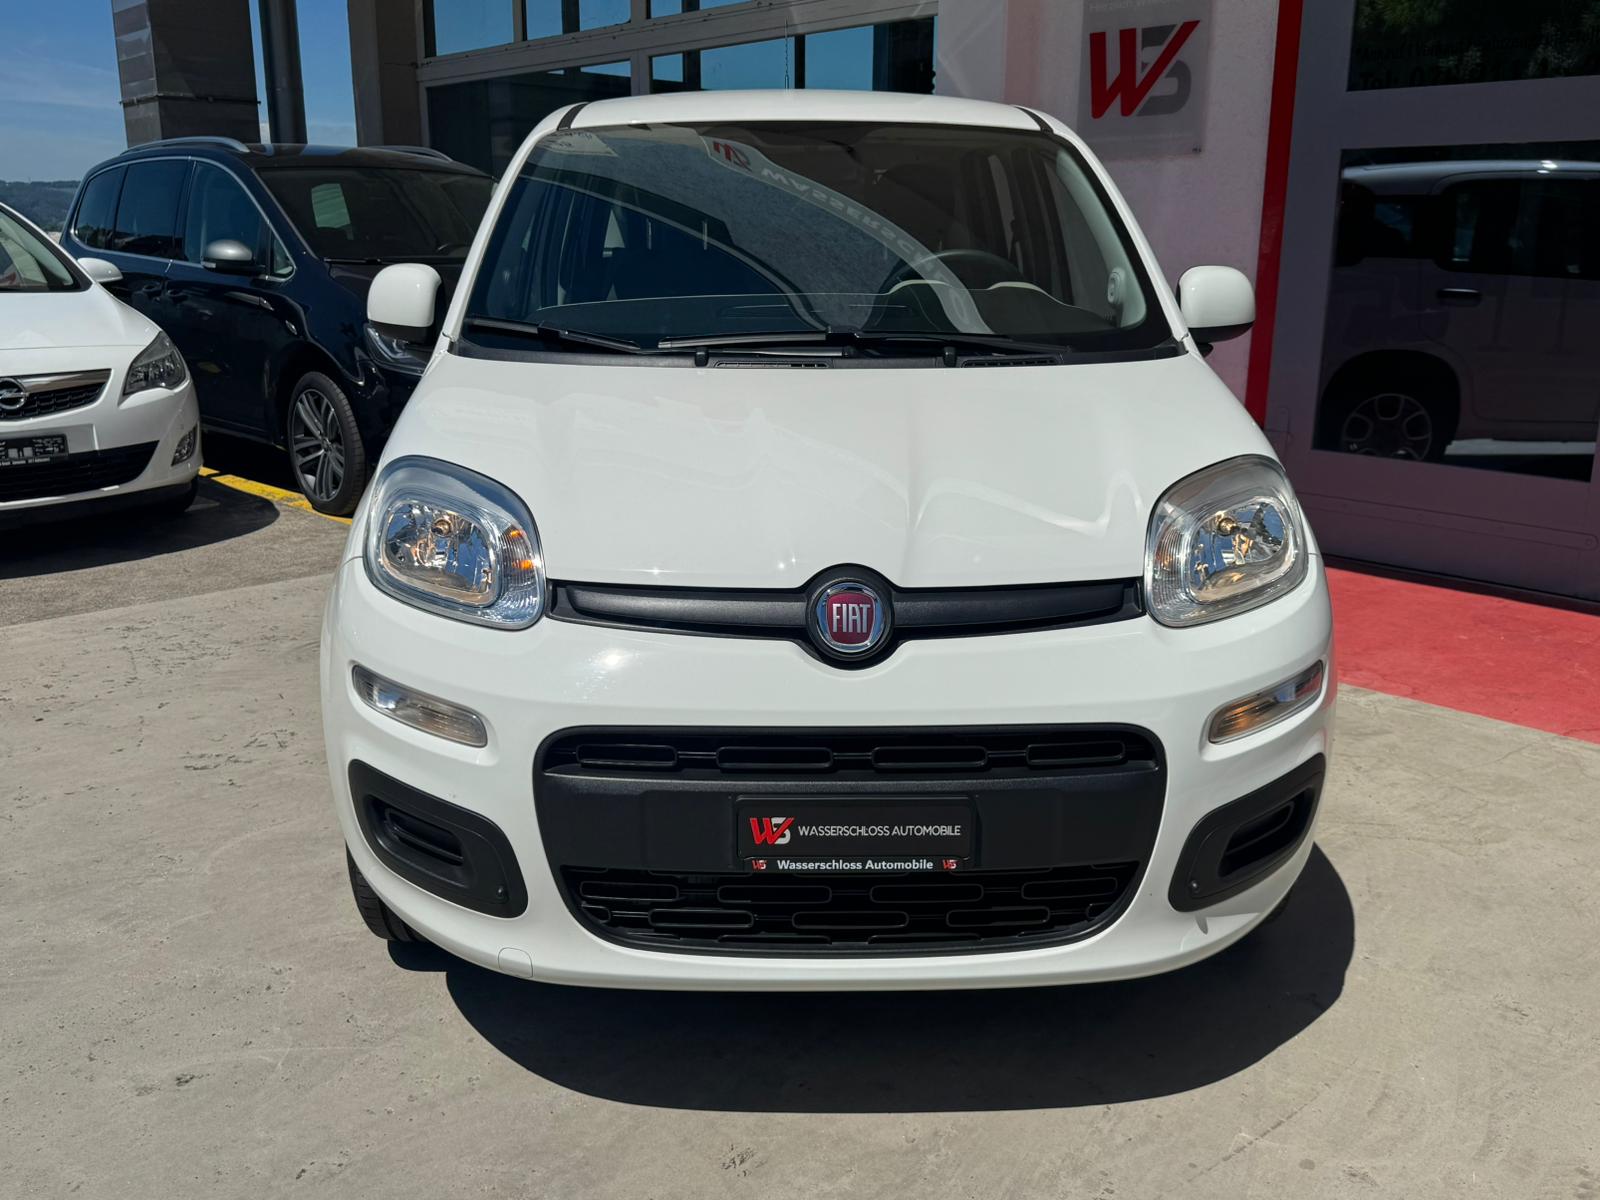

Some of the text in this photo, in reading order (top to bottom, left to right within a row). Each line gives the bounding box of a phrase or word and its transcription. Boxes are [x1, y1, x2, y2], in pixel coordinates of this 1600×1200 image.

[832, 603, 871, 633] FIAT
[798, 825, 890, 837] WASSERSCHLOSS
[891, 825, 961, 837] AUTOMOBILE
[777, 859, 863, 870] Wasserschloss
[865, 859, 934, 870] Automobile
